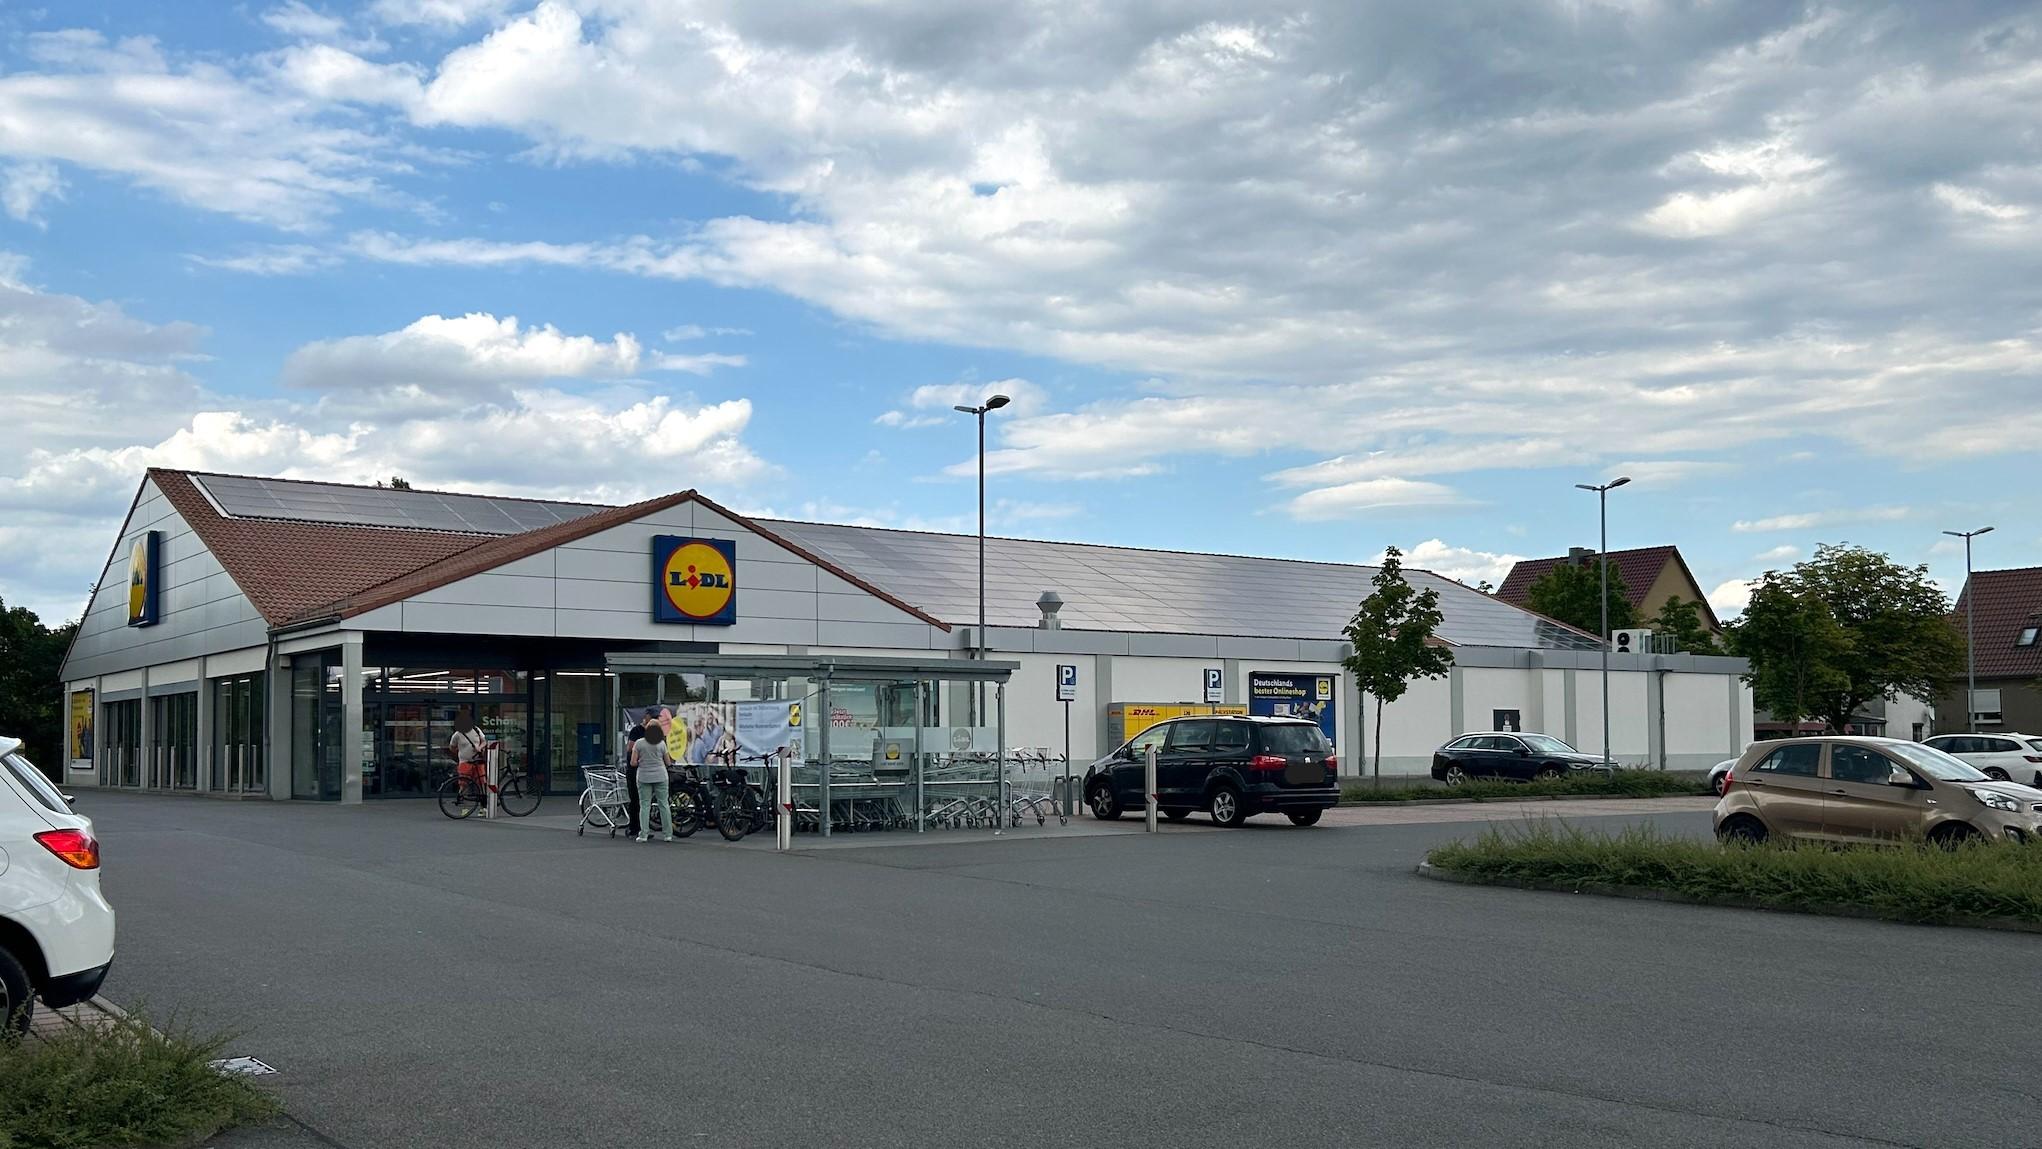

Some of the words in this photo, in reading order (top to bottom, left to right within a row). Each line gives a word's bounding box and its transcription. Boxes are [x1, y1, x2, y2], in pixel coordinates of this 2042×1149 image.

[1062, 666, 1073, 684] P
[1209, 670, 1219, 687] P
[1253, 678, 1293, 687] Deutschlands
[1254, 687, 1272, 695] bester
[1273, 687, 1307, 697] Onlineshop
